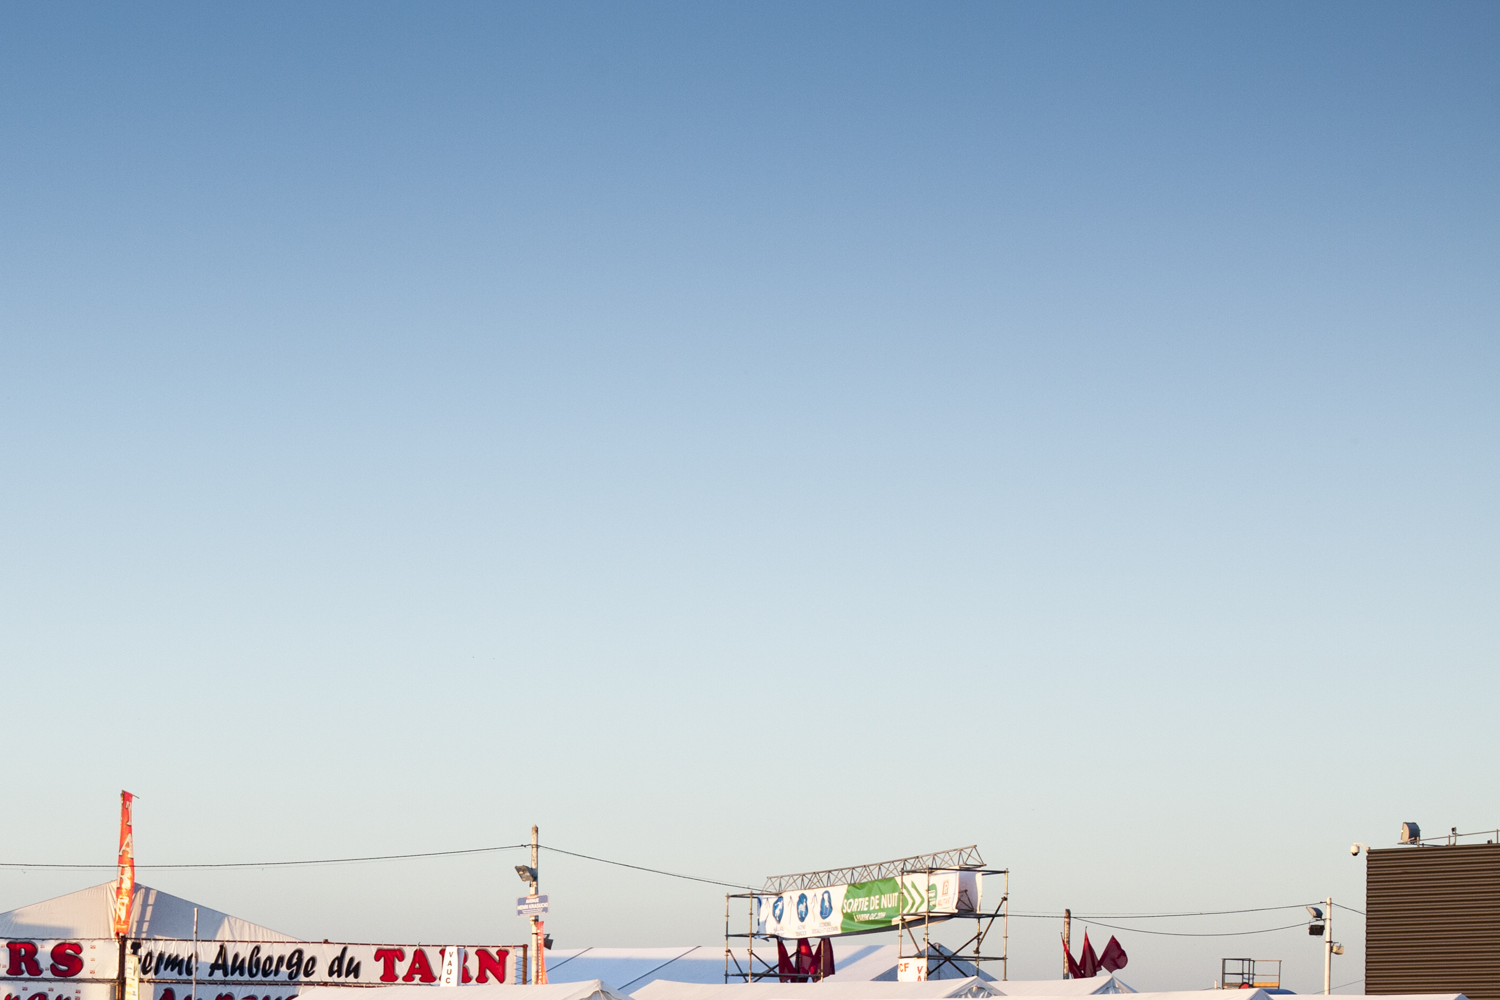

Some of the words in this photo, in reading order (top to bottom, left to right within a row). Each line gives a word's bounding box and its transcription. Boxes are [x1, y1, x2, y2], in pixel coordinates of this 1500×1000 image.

[842, 897, 869, 914] SORTIE
[870, 895, 880, 911] DE
[881, 892, 899, 909] NUIT
[208, 943, 317, 981] Auberge
[328, 946, 362, 979] du
